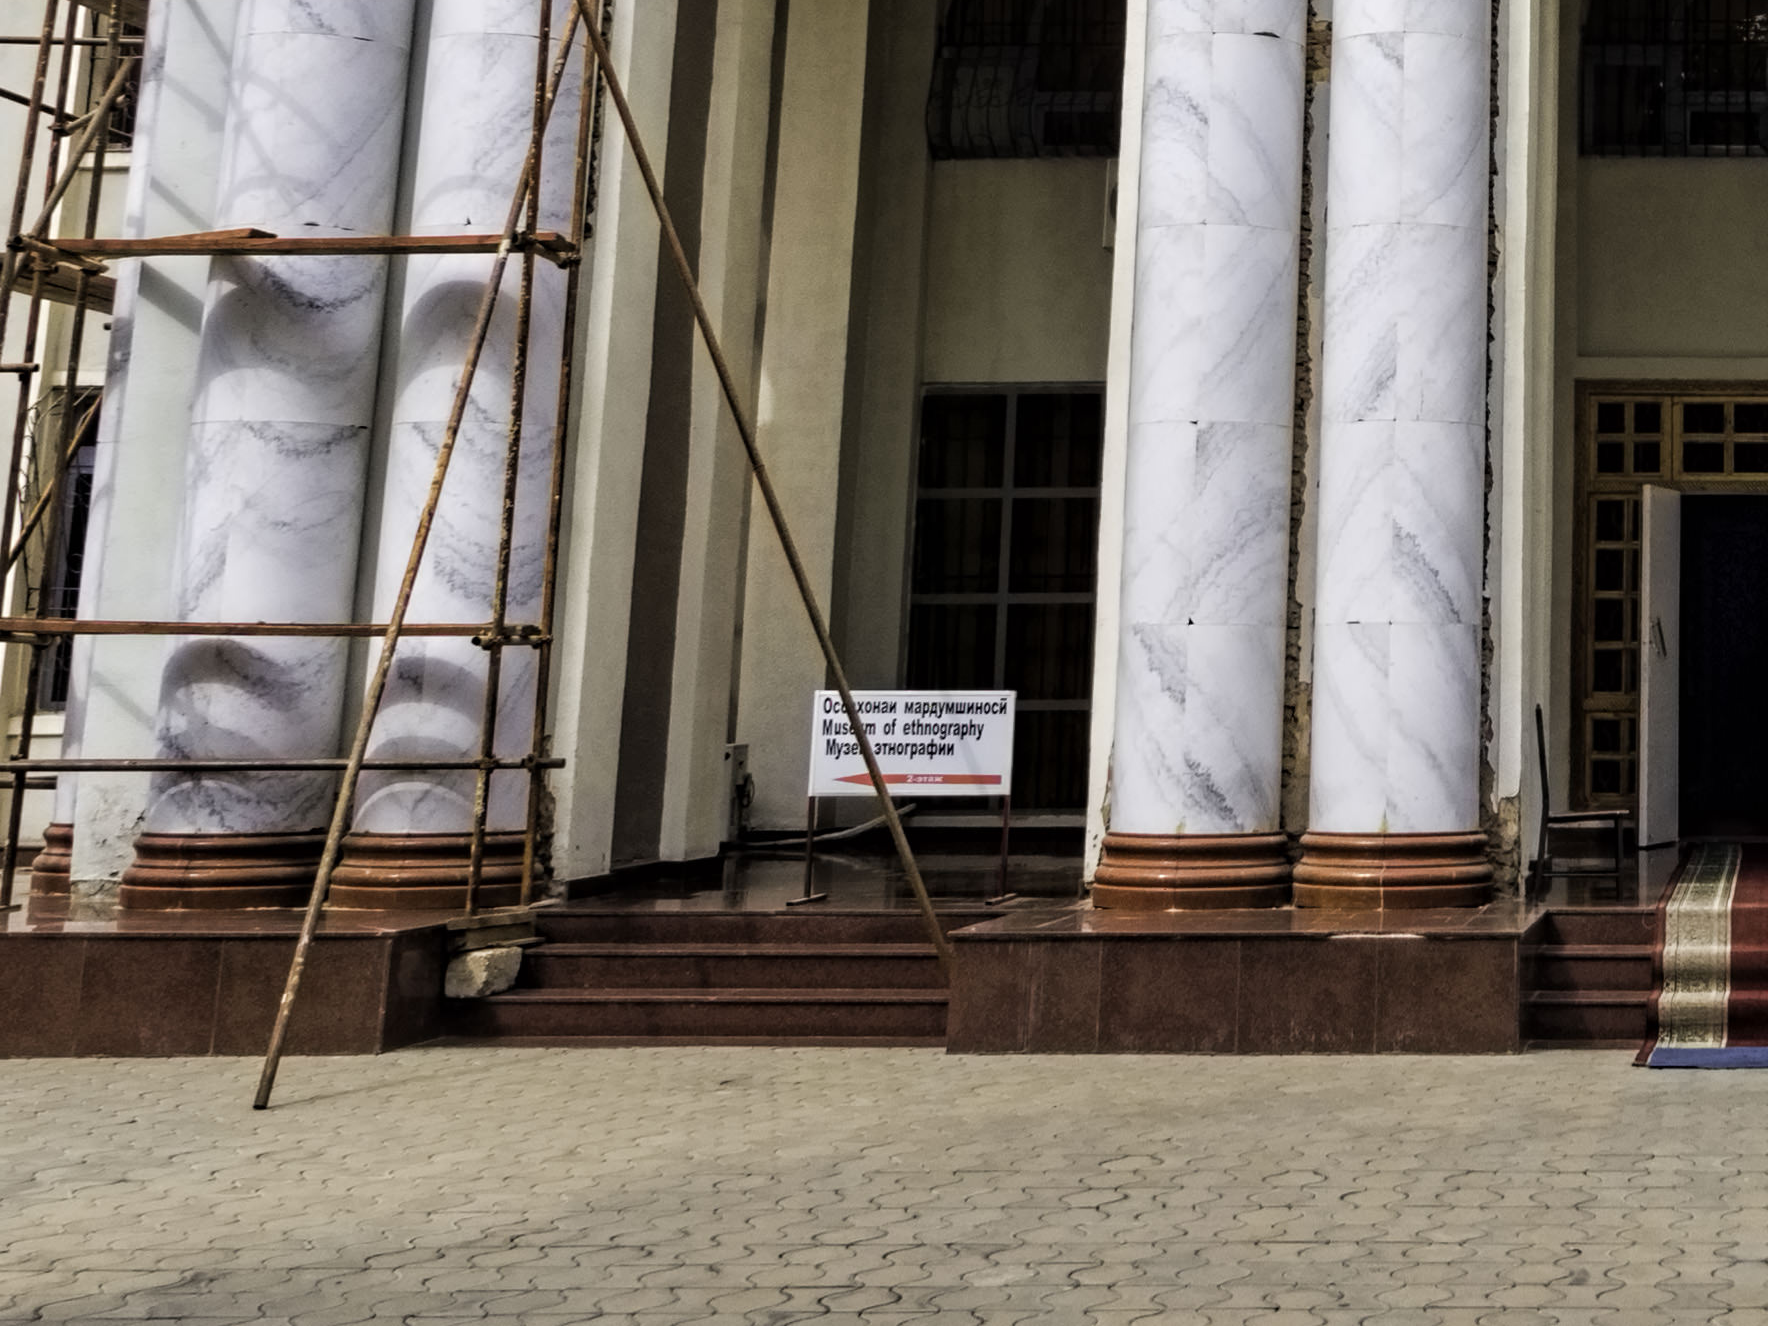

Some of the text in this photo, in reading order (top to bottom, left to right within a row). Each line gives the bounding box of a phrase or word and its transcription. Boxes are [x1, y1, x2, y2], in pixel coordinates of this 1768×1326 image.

[823, 697, 897, 715] Осохонаи
[822, 718, 985, 740] Musem of ethnography
[826, 738, 955, 759] Музе этнографии
[906, 774, 944, 783] 2-этаж
